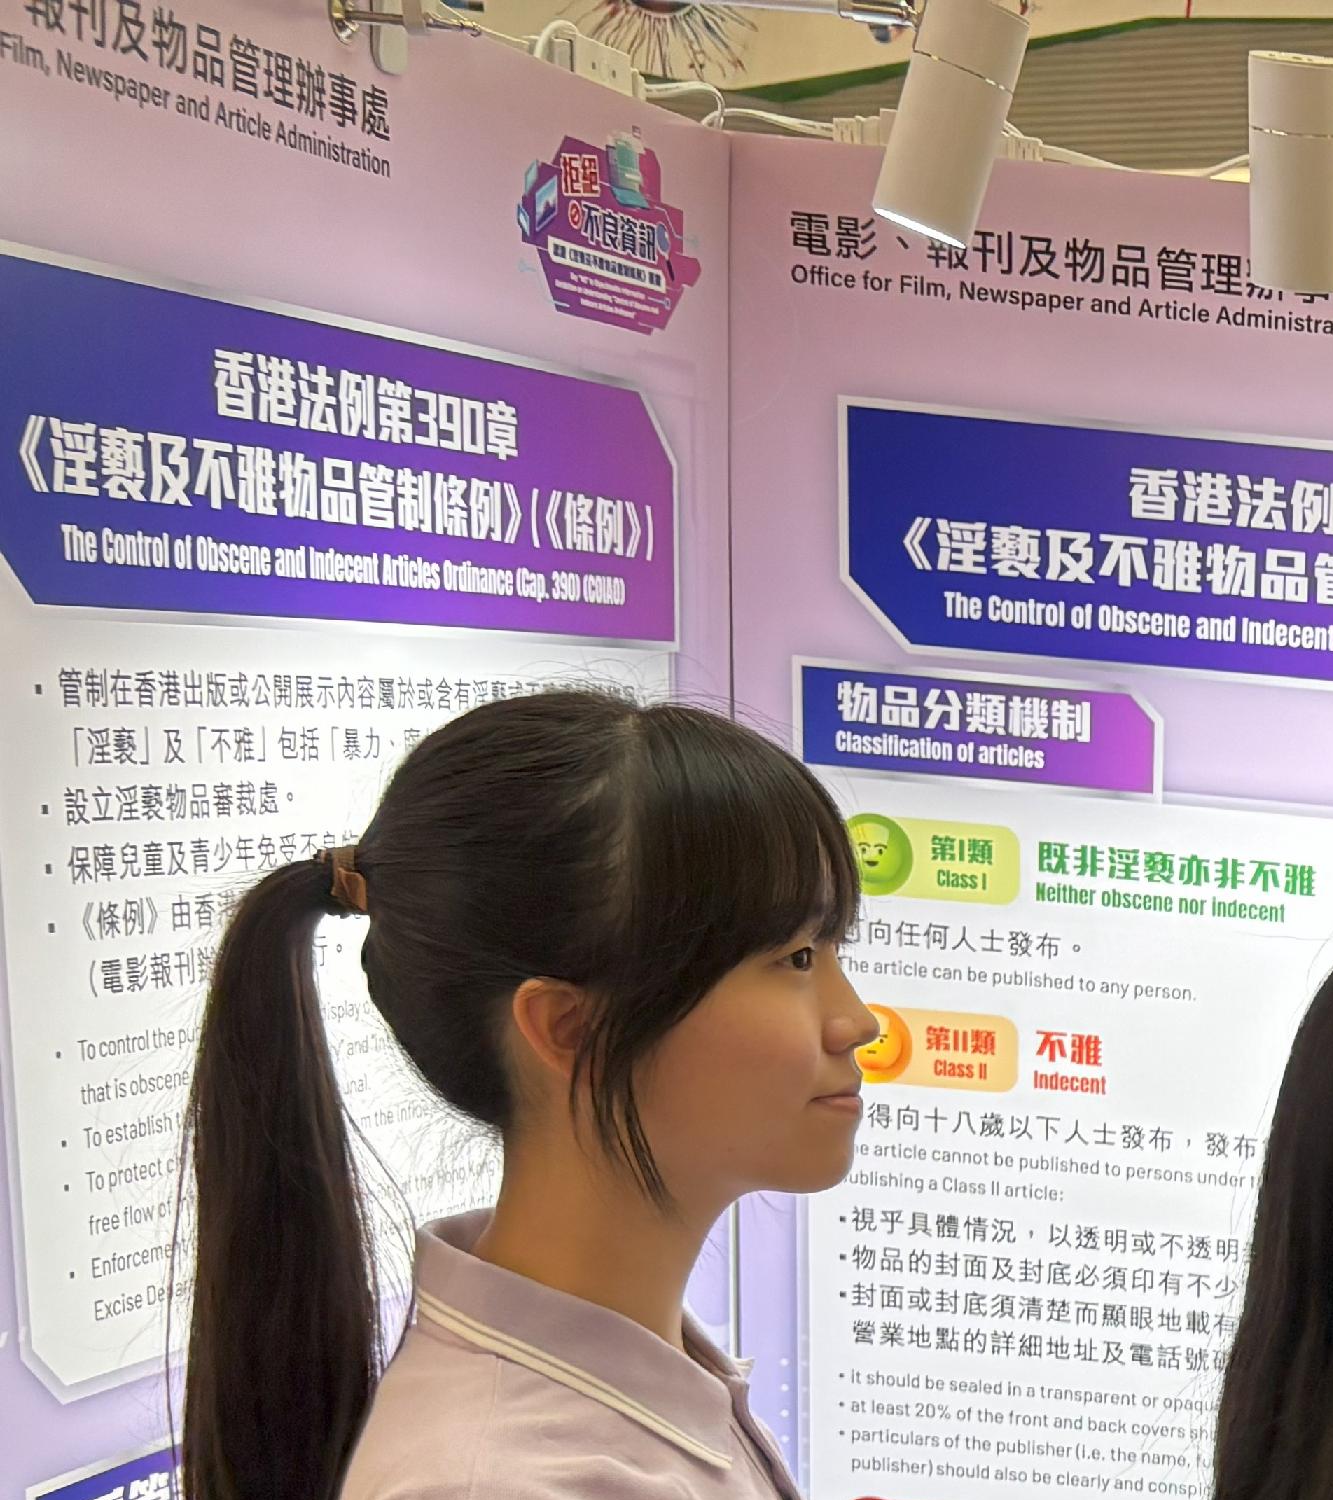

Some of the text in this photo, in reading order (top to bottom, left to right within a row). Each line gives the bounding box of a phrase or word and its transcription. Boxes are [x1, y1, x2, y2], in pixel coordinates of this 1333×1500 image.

[0, 30, 390, 178] Film, Newspaper and Article Administration
[561, 154, 600, 195] 拒絕
[581, 202, 657, 263] 不良資訊
[791, 264, 855, 289] Office
[863, 270, 892, 292] for
[901, 275, 951, 300] Film,
[960, 280, 1084, 313] Newspaper
[1091, 295, 1130, 316] and
[1139, 298, 1209, 323] Article
[214, 348, 518, 460] 香港法例第390章
[61, 524, 625, 605] The Control of Obscene and Indecent Articles Ordinance (Cap. 390) (COIAO)
[944, 591, 982, 620] The
[988, 595, 1064, 627] Control
[1071, 603, 1092, 630] of
[1099, 604, 1190, 638] Obscene
[1196, 615, 1236, 642] and
[836, 681, 1093, 745] 物品分類機制
[836, 730, 1044, 769] Classification of articles
[63, 780, 295, 827] 設立淫褻物品審裁處。
[930, 834, 994, 867] 第I類
[1037, 840, 1317, 897] 既非淫褻亦非不雅
[937, 869, 986, 890] Class I
[1036, 882, 1284, 923] Neither obscene nor indecent
[874, 959, 927, 978] article
[933, 967, 962, 981] can
[968, 966, 987, 983] be
[993, 970, 1073, 990] published
[1079, 977, 1095, 993] to
[1100, 981, 1129, 999] any
[1134, 984, 1195, 1001] person.
[925, 1025, 996, 1057] 第II類
[1034, 1030, 1104, 1068] 不雅
[81, 1068, 189, 1105] that is obscene
[934, 1059, 987, 1080] Class II
[1033, 1070, 1107, 1096] Indecent
